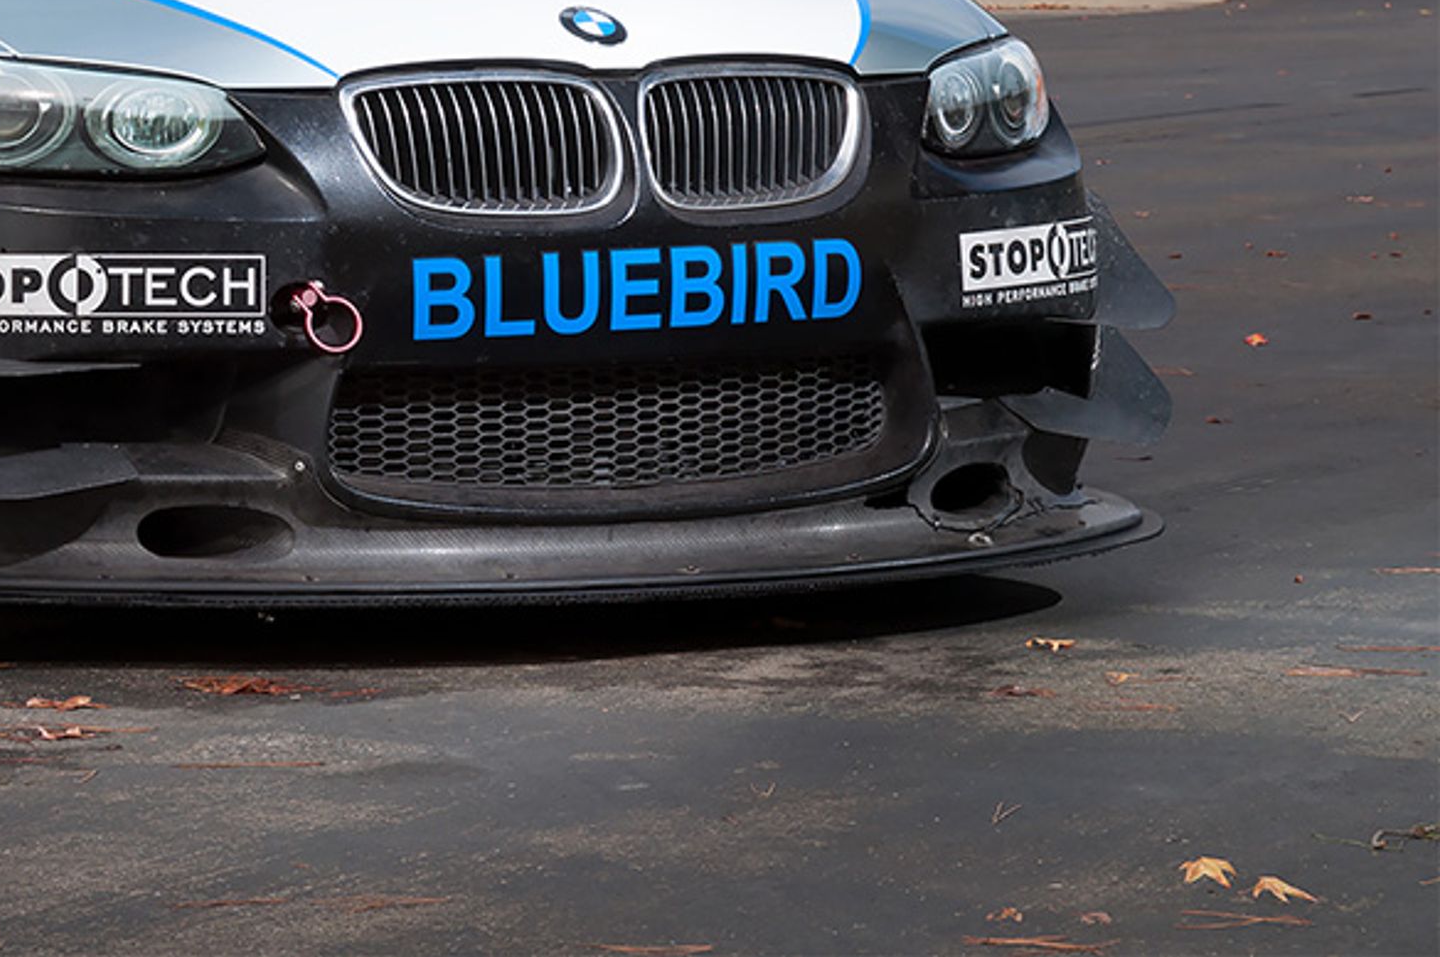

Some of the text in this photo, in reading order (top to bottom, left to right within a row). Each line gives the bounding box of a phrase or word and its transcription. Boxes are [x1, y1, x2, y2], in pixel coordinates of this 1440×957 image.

[969, 238, 1045, 280] STOP
[108, 266, 256, 307] TECH
[412, 238, 861, 341] BLUEBIRD
[102, 320, 168, 334] BRAKE
[177, 320, 266, 335] SYSTEMS
